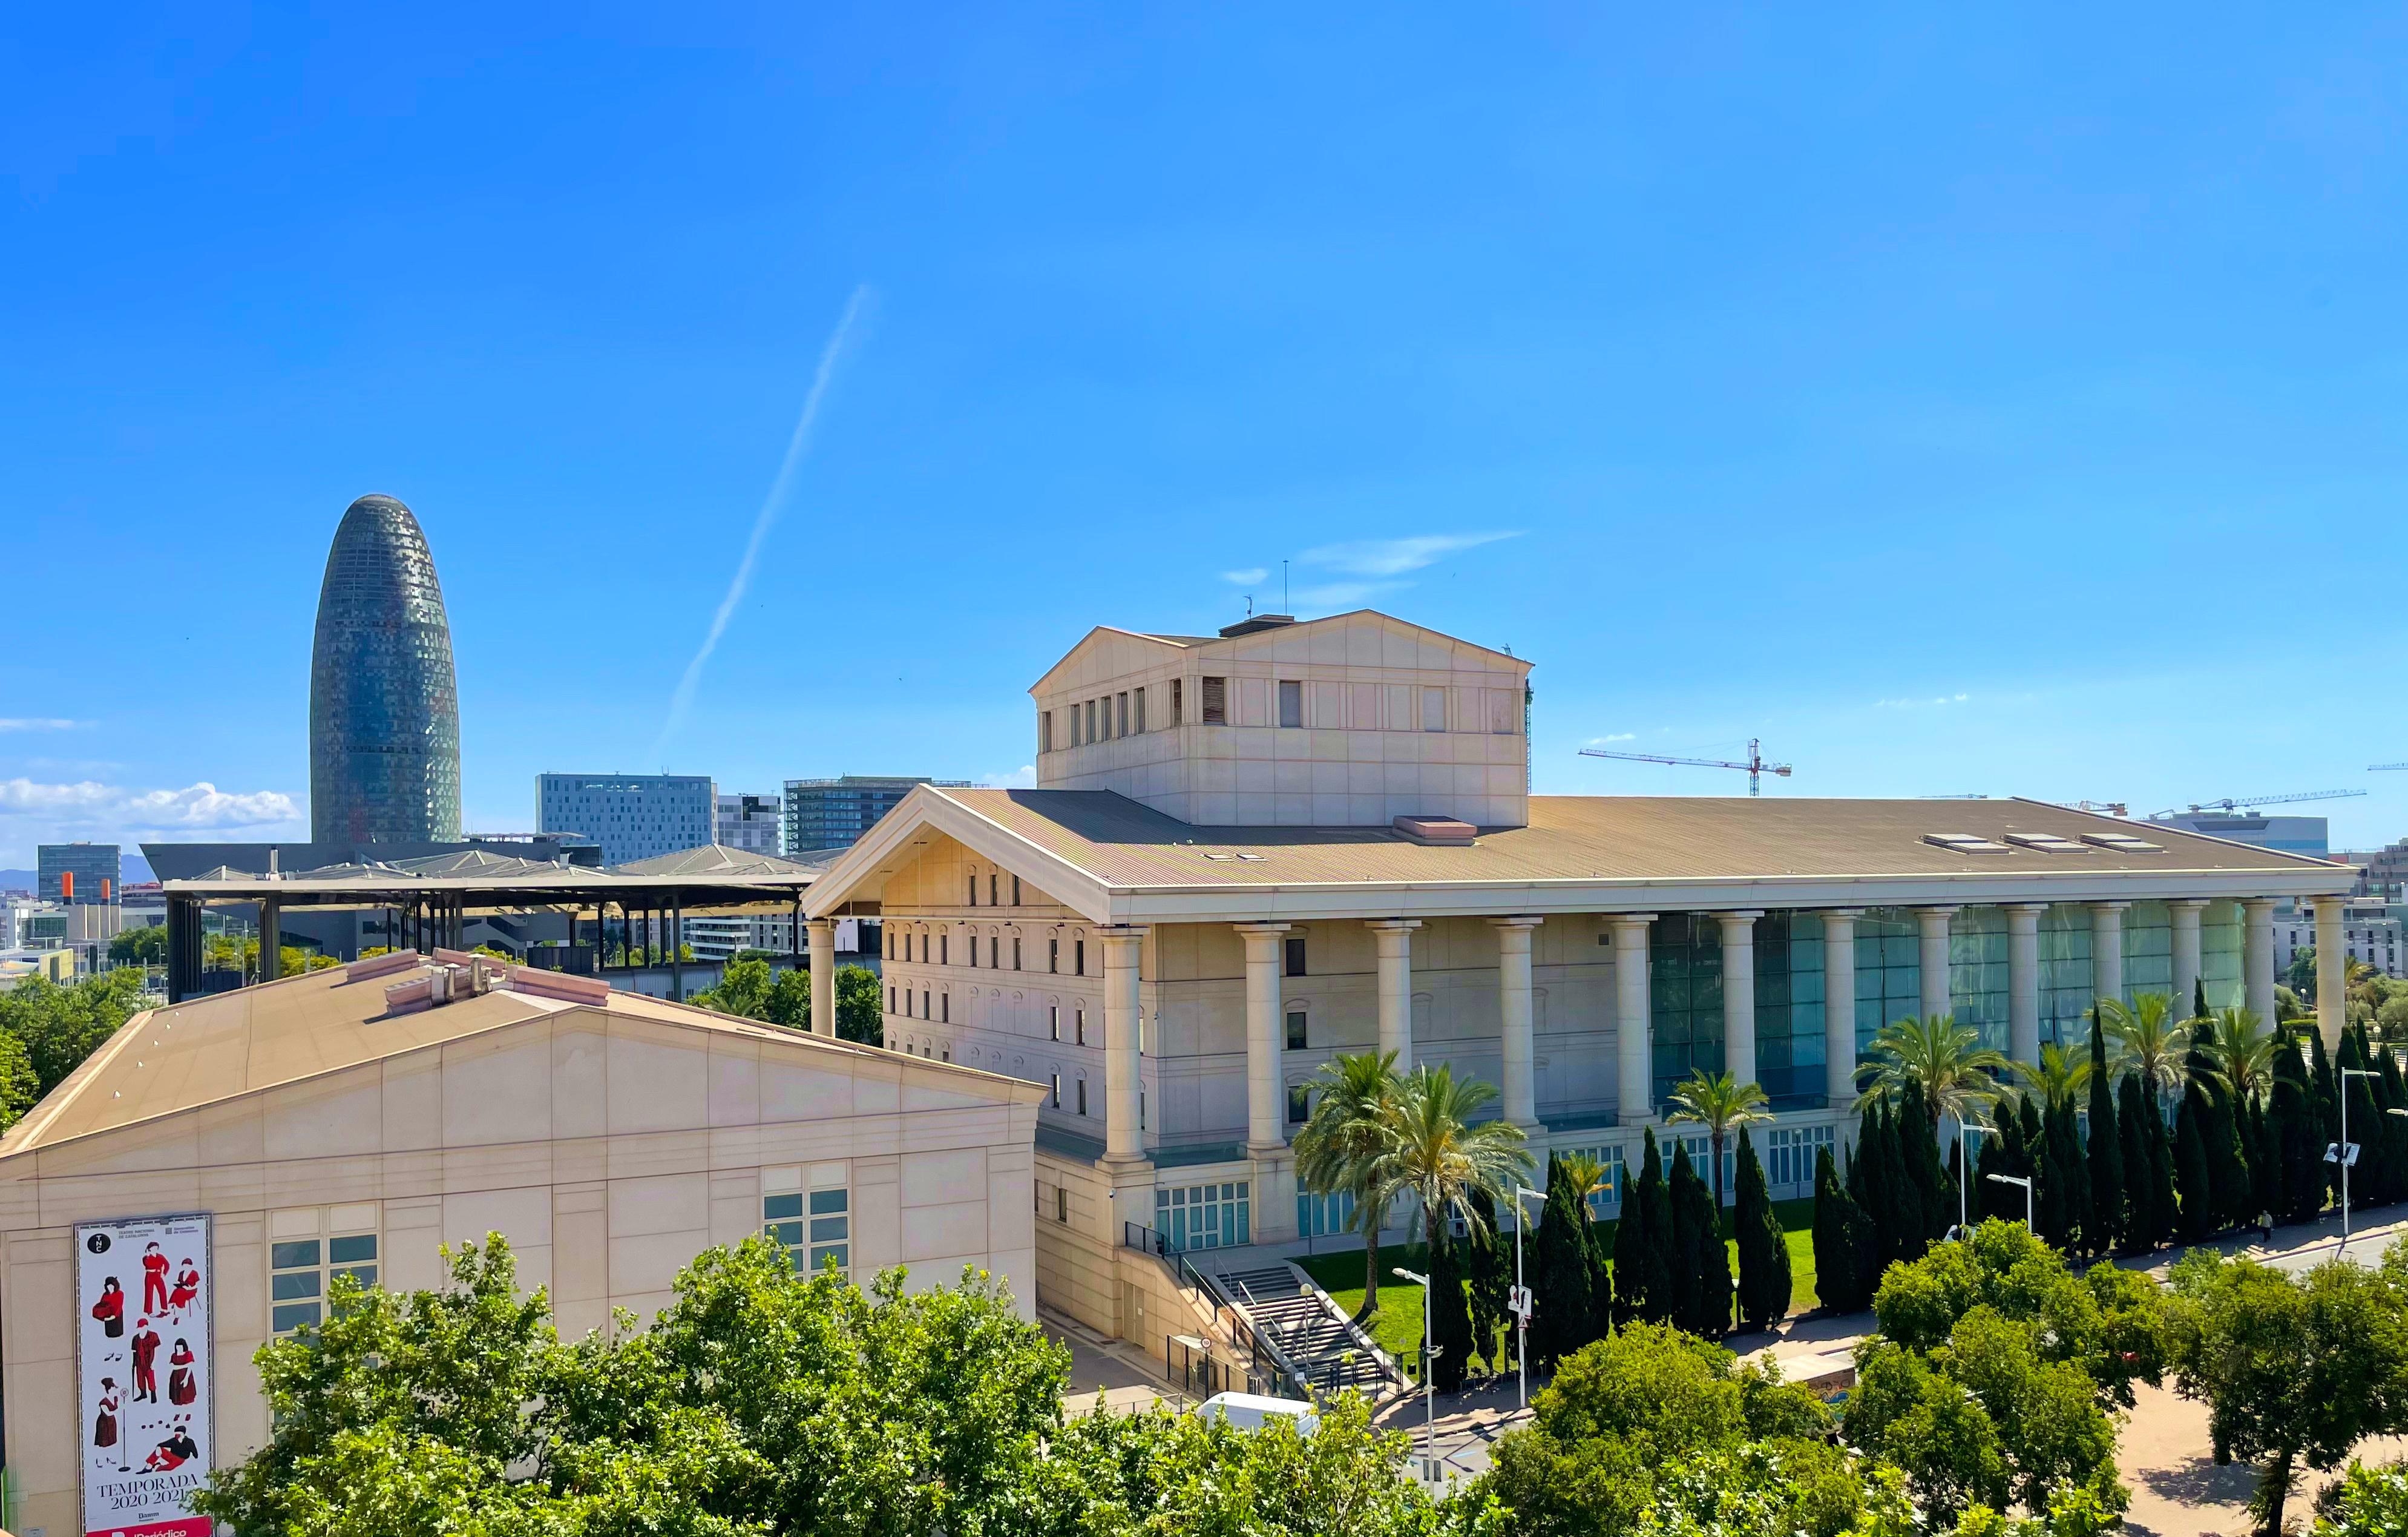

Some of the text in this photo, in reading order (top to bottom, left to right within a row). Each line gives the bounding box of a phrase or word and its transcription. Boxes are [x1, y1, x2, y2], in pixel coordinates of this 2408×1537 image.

[97, 1473, 198, 1498] TEMPORADA
[111, 1489, 185, 1510] 2020 2021
